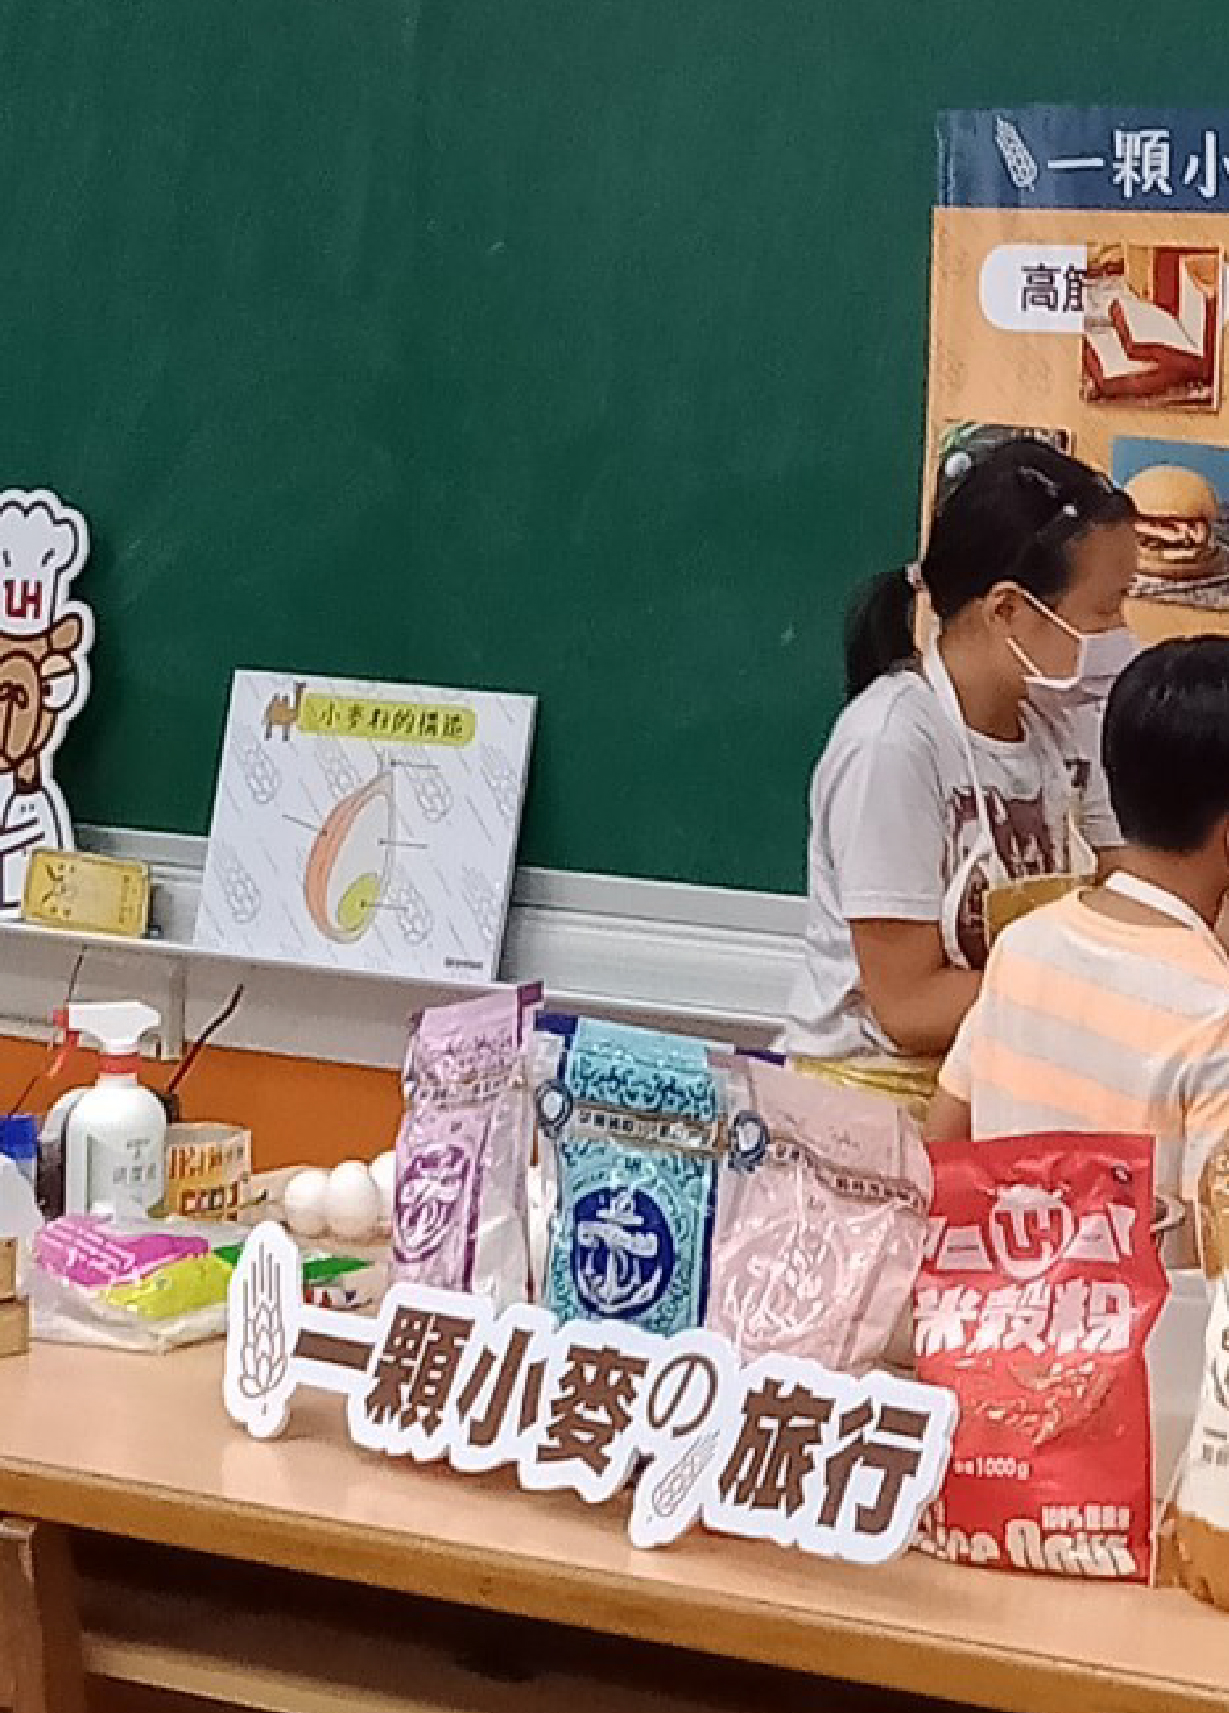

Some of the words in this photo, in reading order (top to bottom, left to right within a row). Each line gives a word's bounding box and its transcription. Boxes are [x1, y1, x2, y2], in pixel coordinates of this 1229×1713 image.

[912, 1278, 1132, 1357] 米穀粉
[295, 1306, 930, 1536] 一顆小麥の旅行
